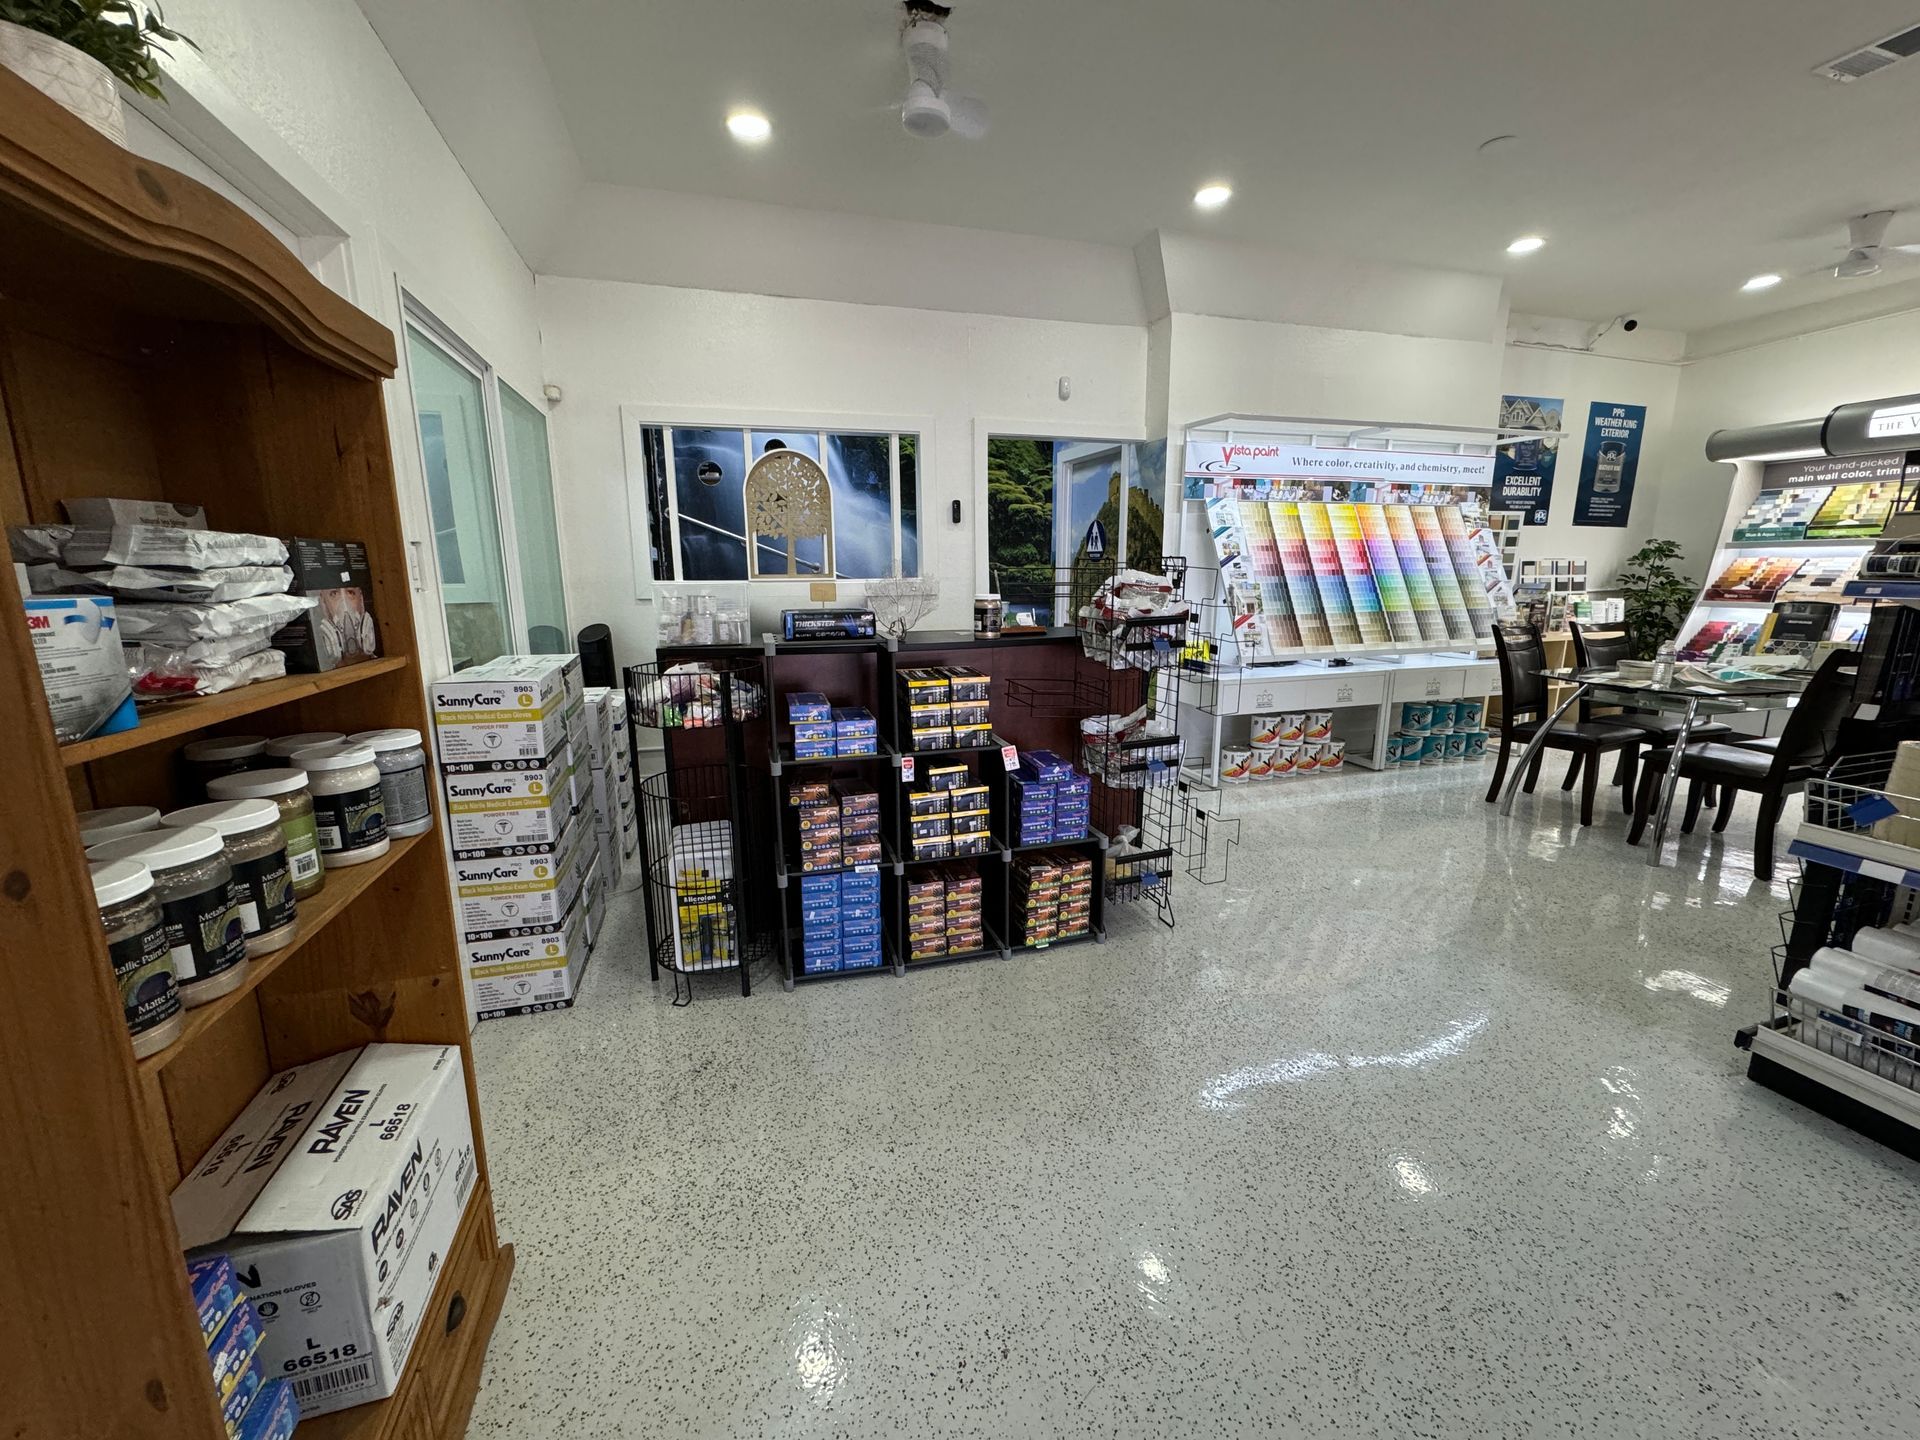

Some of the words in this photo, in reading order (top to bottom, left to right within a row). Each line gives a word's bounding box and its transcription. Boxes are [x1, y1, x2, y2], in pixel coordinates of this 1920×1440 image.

[1612, 408, 1625, 418] PPG
[1595, 417, 1623, 428] WEATHER
[1623, 420, 1639, 429] KING
[1878, 421, 1904, 431] THE
[1601, 428, 1630, 438] EXTERIOR
[1253, 445, 1280, 460] paint
[1292, 457, 1323, 466] Where
[1325, 459, 1352, 469] color,
[1354, 460, 1398, 472] creativity,
[1400, 462, 1416, 471] and
[1417, 463, 1461, 475] chemistry,
[1463, 466, 1485, 474] meet!
[1803, 465, 1825, 473] Your
[1828, 457, 1900, 470] hand-picked
[1505, 476, 1542, 486] EXCELLENT
[1788, 473, 1814, 483] main
[1817, 472, 1838, 481] wall
[1876, 467, 1900, 476] trim
[1905, 466, 1920, 474] an
[1502, 487, 1542, 496] DURABILITY
[27, 616, 50, 629] 3M
[795, 620, 836, 628] THICKSTER
[437, 693, 501, 708] SunnyCare
[522, 695, 530, 704] L
[450, 782, 512, 797] SunnyCare
[533, 783, 540, 792] L
[459, 867, 518, 881] SunnyCare
[538, 867, 546, 875] L
[541, 936, 560, 944] 8903
[471, 947, 530, 963] SunnyCare
[549, 945, 556, 954] L
[114, 959, 140, 976] tallic
[141, 949, 163, 964] Paint
[138, 995, 166, 1015] Matte
[307, 1089, 370, 1154] RAVEN
[380, 1103, 411, 1141] 66518
[243, 1100, 313, 1174] RAVEN
[201, 1134, 245, 1177] 66518
[371, 1138, 423, 1255] RAVEN
[331, 1189, 363, 1220] SAS
[250, 1290, 281, 1301] NATION
[283, 1281, 317, 1295] GLOVES
[306, 1338, 321, 1350] L
[283, 1343, 357, 1372] 66518
